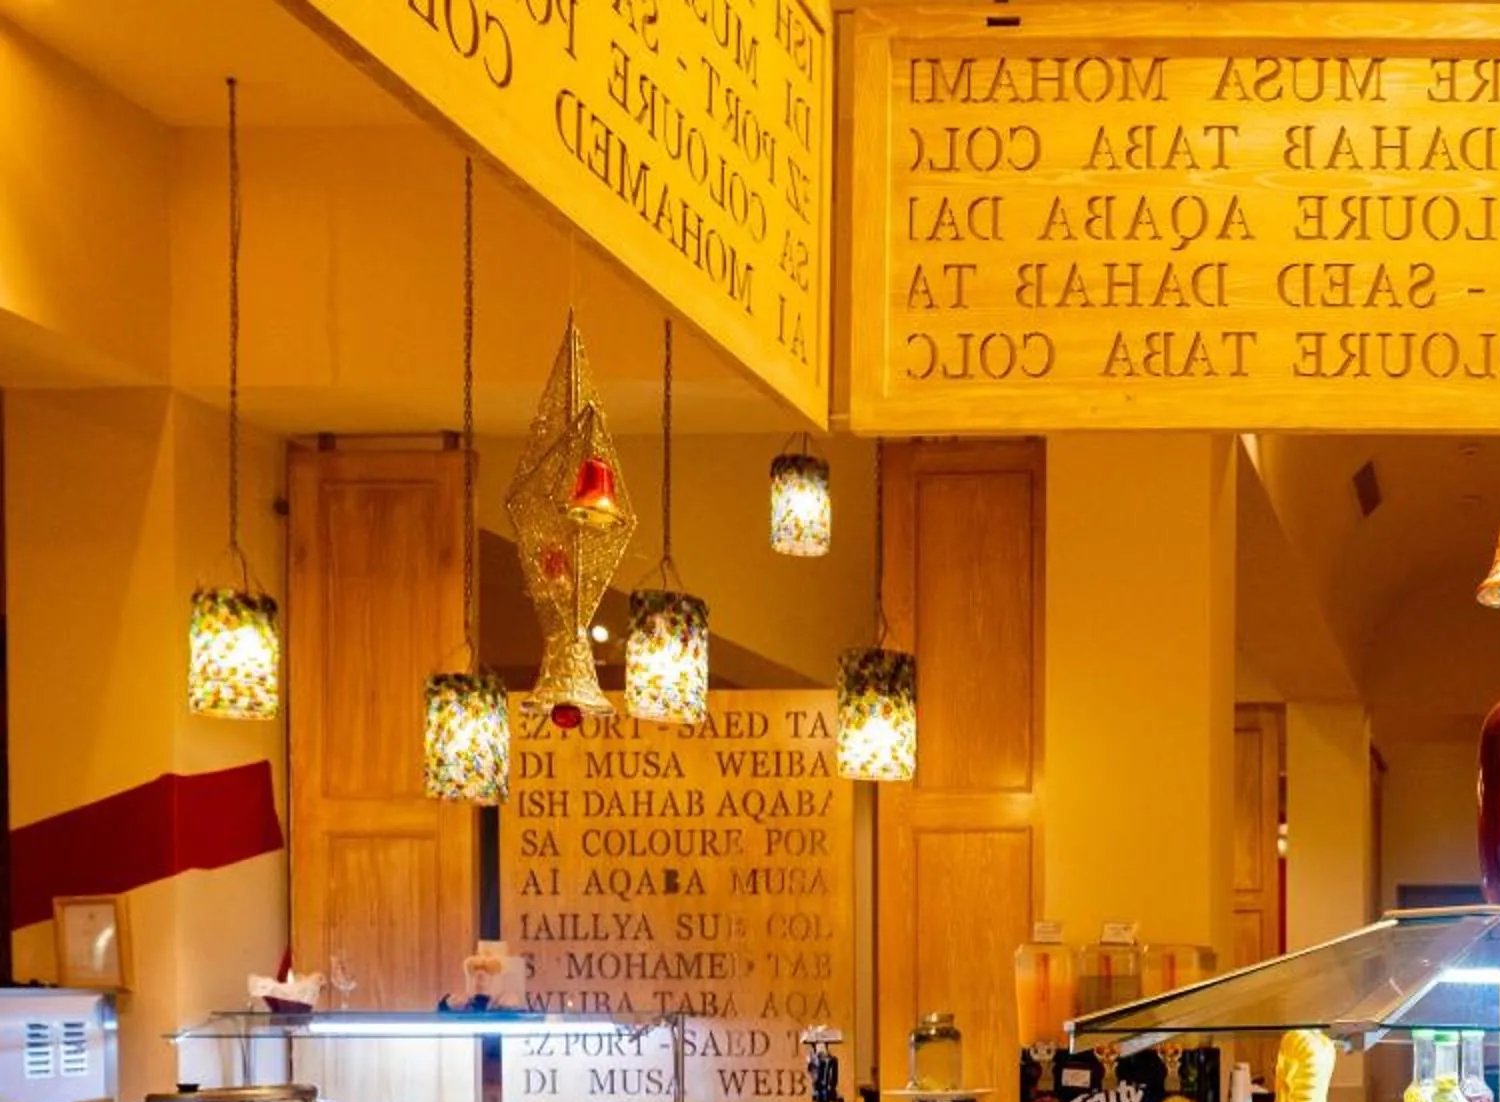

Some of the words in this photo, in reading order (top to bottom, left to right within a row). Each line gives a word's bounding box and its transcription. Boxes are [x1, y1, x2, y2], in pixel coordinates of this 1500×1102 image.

[784, 711, 832, 739] TA
[519, 751, 556, 779] DI
[585, 750, 686, 779] MUSA
[715, 750, 832, 778] WEIBA
[517, 790, 569, 818] ISH
[582, 789, 706, 818] DAHAB
[520, 828, 561, 858] SA
[581, 828, 745, 859] COLOURE
[764, 828, 831, 858] POR
[582, 867, 707, 902] AQABA
[730, 867, 830, 897] MUSA
[565, 951, 757, 980] MOHAMED
[653, 991, 740, 1019] TABA
[760, 990, 833, 1021] AQA
[565, 1030, 646, 1057] PORT
[683, 1029, 770, 1058] SAED
[523, 1068, 560, 1096] DI
